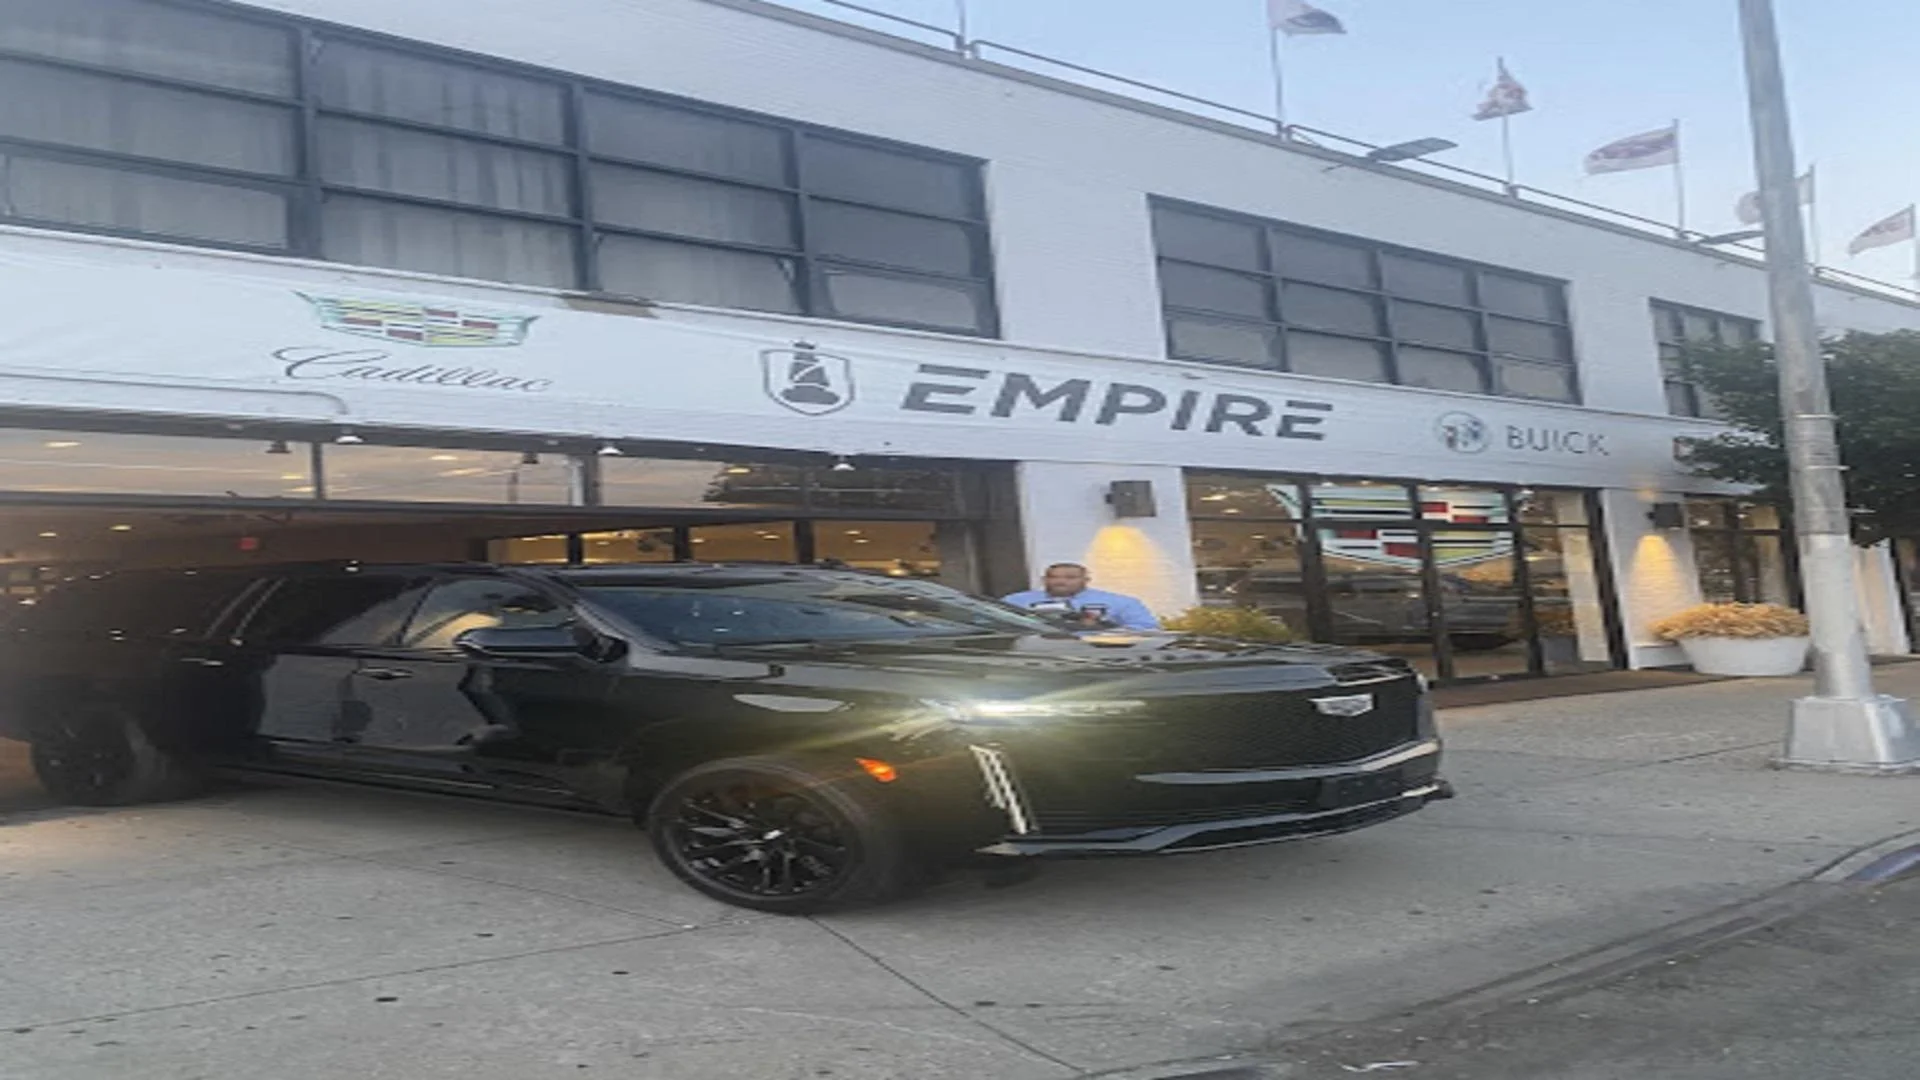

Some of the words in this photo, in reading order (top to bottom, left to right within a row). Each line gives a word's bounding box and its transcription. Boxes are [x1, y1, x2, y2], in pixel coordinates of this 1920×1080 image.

[272, 346, 553, 392] Cadillac
[901, 363, 1333, 441] EMPIRE
[1506, 425, 1610, 456] BUICK
